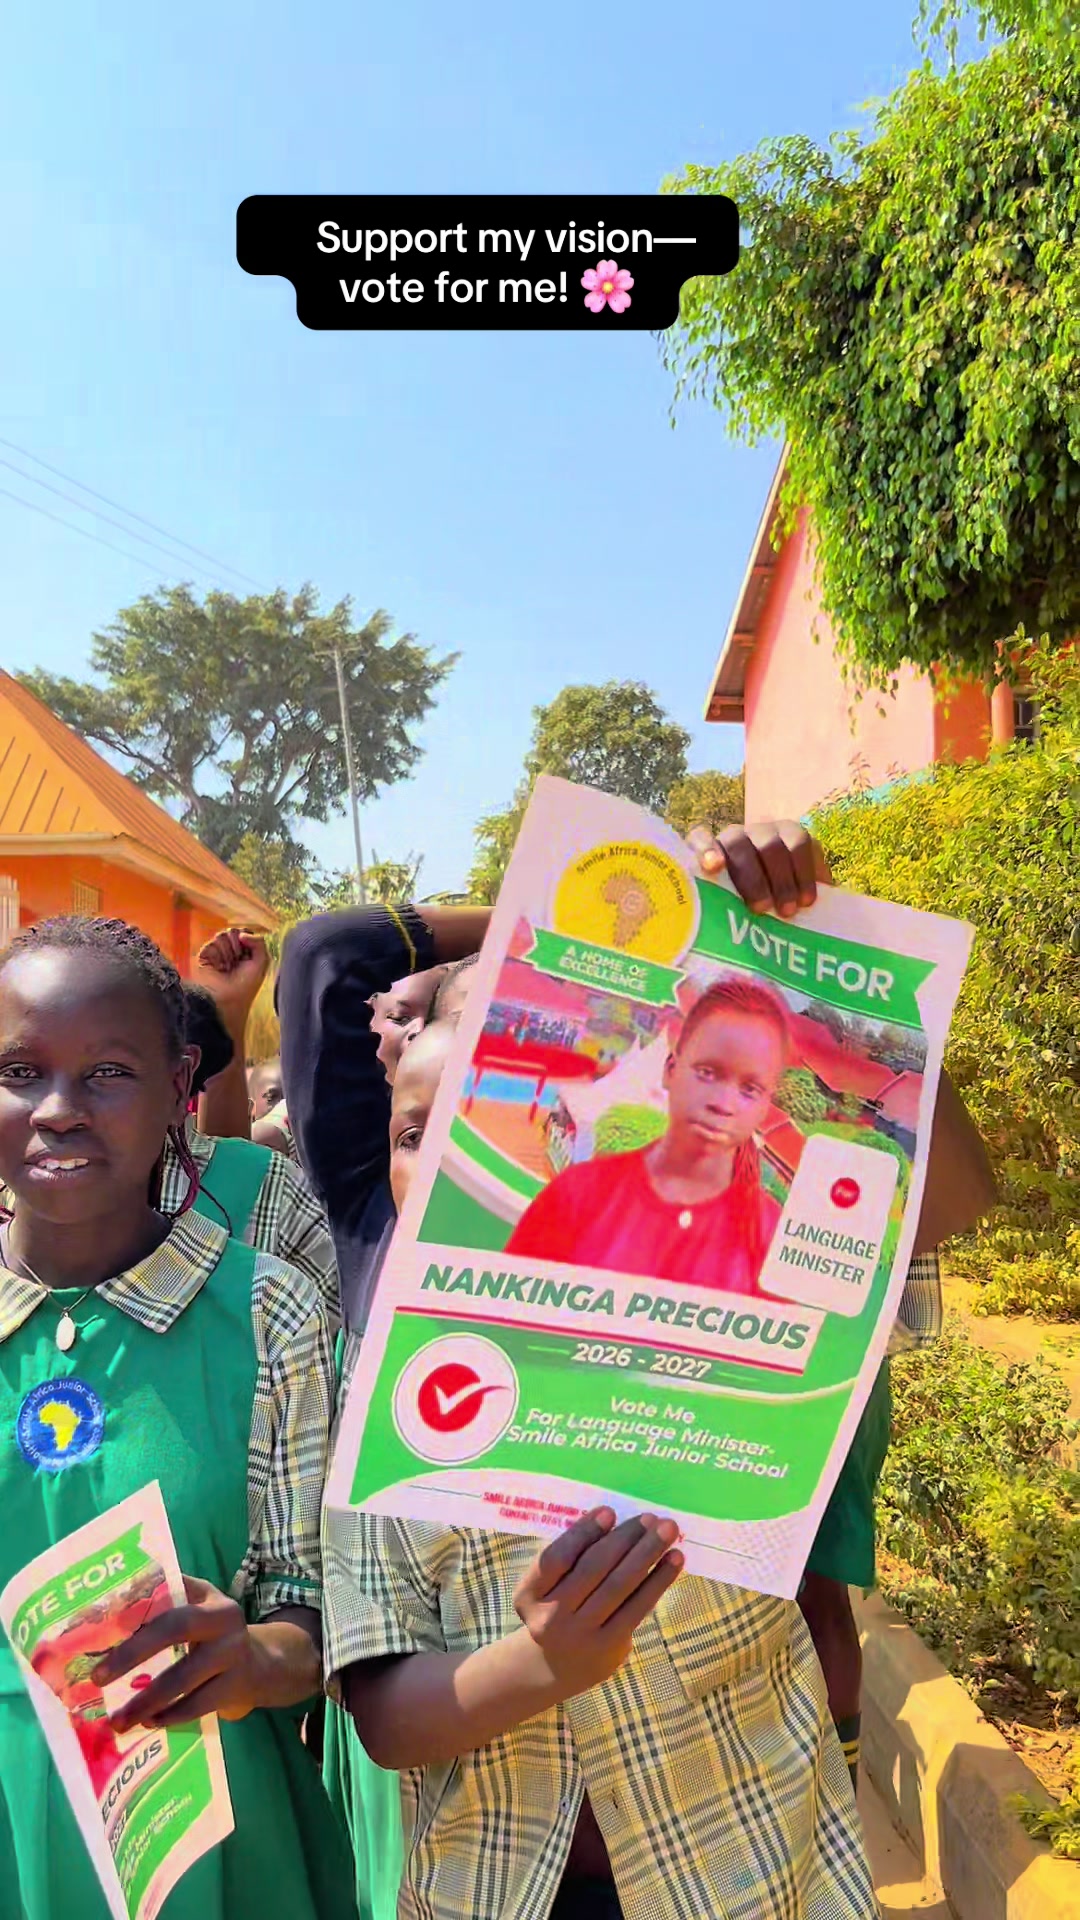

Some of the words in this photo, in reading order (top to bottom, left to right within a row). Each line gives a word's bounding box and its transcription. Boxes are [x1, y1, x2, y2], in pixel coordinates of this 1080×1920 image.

[727, 908, 808, 976] VOTE
[816, 951, 894, 1001] FOR
[784, 1218, 877, 1260] LANGUAGE
[779, 1244, 865, 1285] MINISTER
[421, 1263, 615, 1315] NANKINGA
[624, 1292, 811, 1350] PRECIOUS
[571, 1343, 631, 1368] 2026
[650, 1353, 712, 1379] 2027
[57, 1380, 86, 1394] Junior
[525, 1407, 563, 1427] For
[567, 1412, 676, 1441] Language
[610, 1395, 657, 1418] Vote
[663, 1403, 696, 1424] Me
[506, 1424, 567, 1447] Smile
[570, 1431, 637, 1454] Africa
[640, 1439, 710, 1465] Junior
[714, 1451, 788, 1479] School
[18, 1589, 61, 1648] OTE
[65, 1552, 126, 1601] FOR
[101, 1739, 163, 1826] ECIOUS
